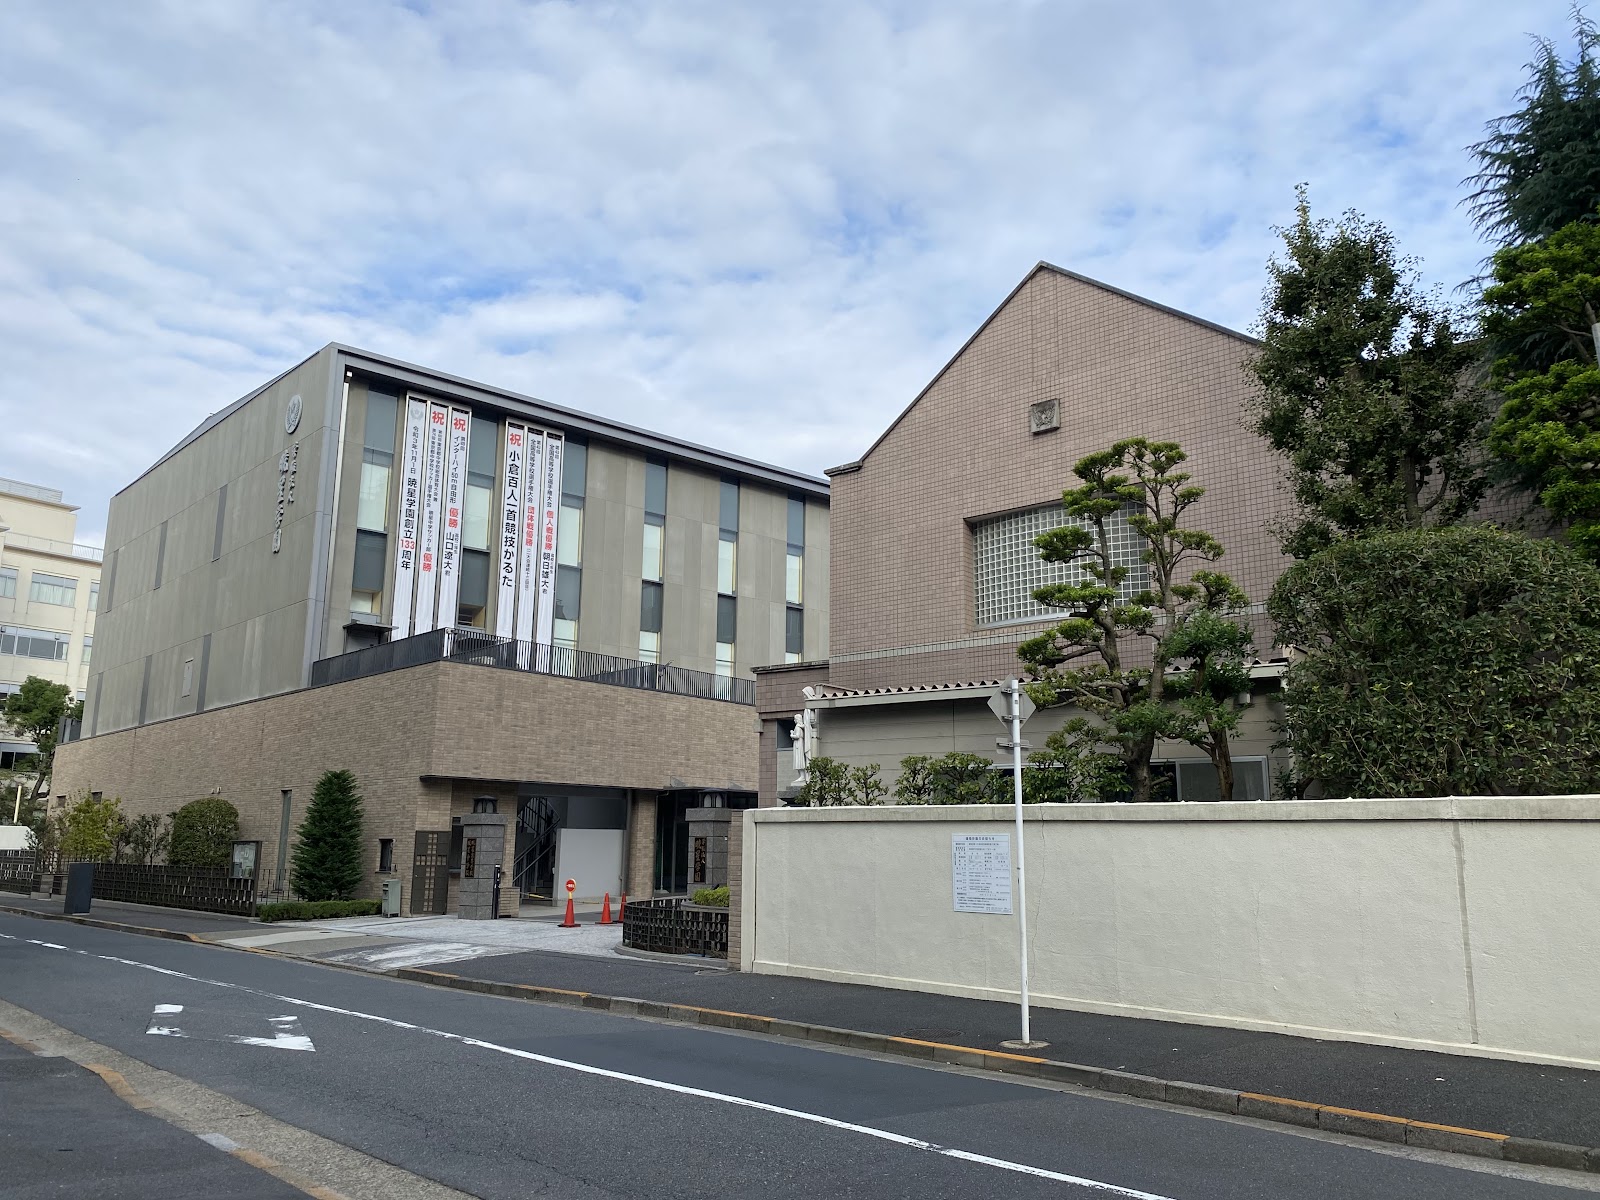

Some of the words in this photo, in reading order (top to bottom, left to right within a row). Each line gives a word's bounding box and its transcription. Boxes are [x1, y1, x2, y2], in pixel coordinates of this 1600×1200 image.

[432, 411, 445, 425] 祝
[454, 417, 466, 431] 祝
[510, 432, 522, 446] 祝
[502, 450, 520, 587] 小倉百人一首競技かるた
